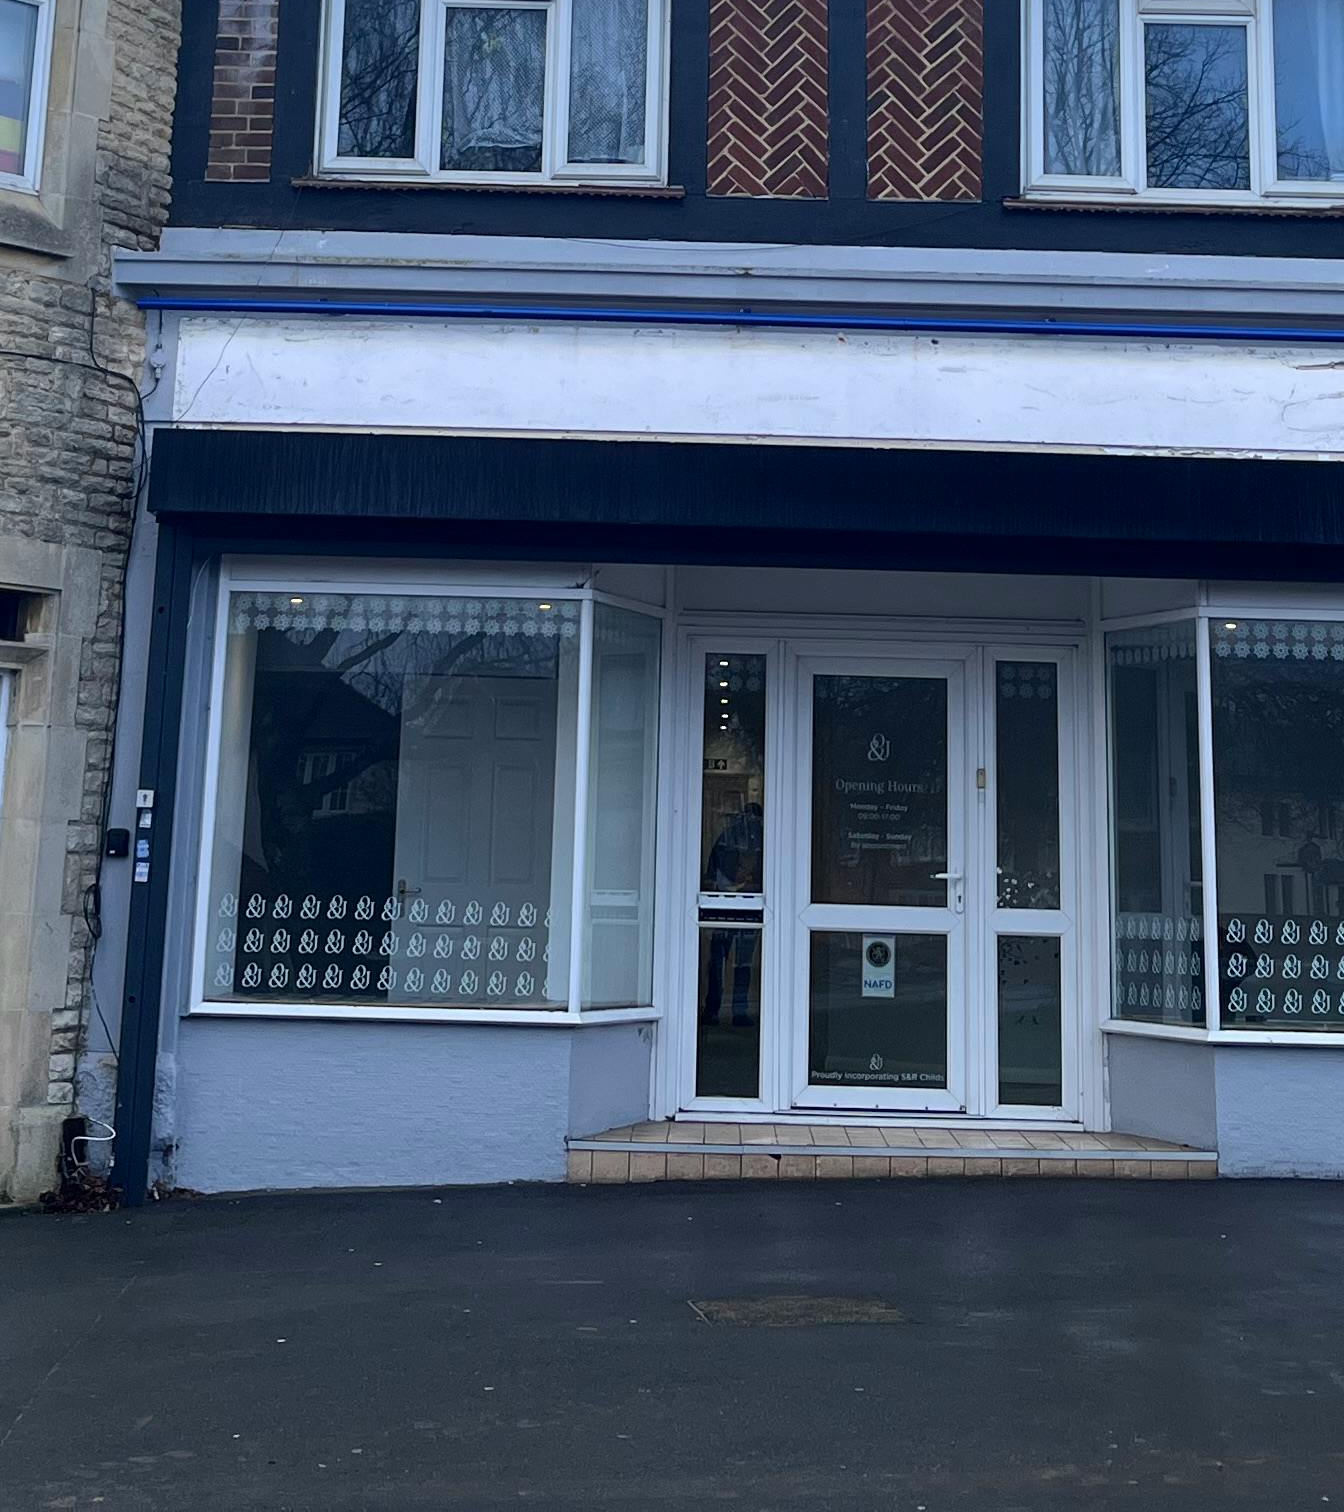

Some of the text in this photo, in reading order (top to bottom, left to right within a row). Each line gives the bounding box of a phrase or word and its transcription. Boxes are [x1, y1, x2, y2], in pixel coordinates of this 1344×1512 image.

[836, 778, 885, 794] Opening
[864, 979, 893, 989] NAFD
[811, 1070, 843, 1081] Proudly
